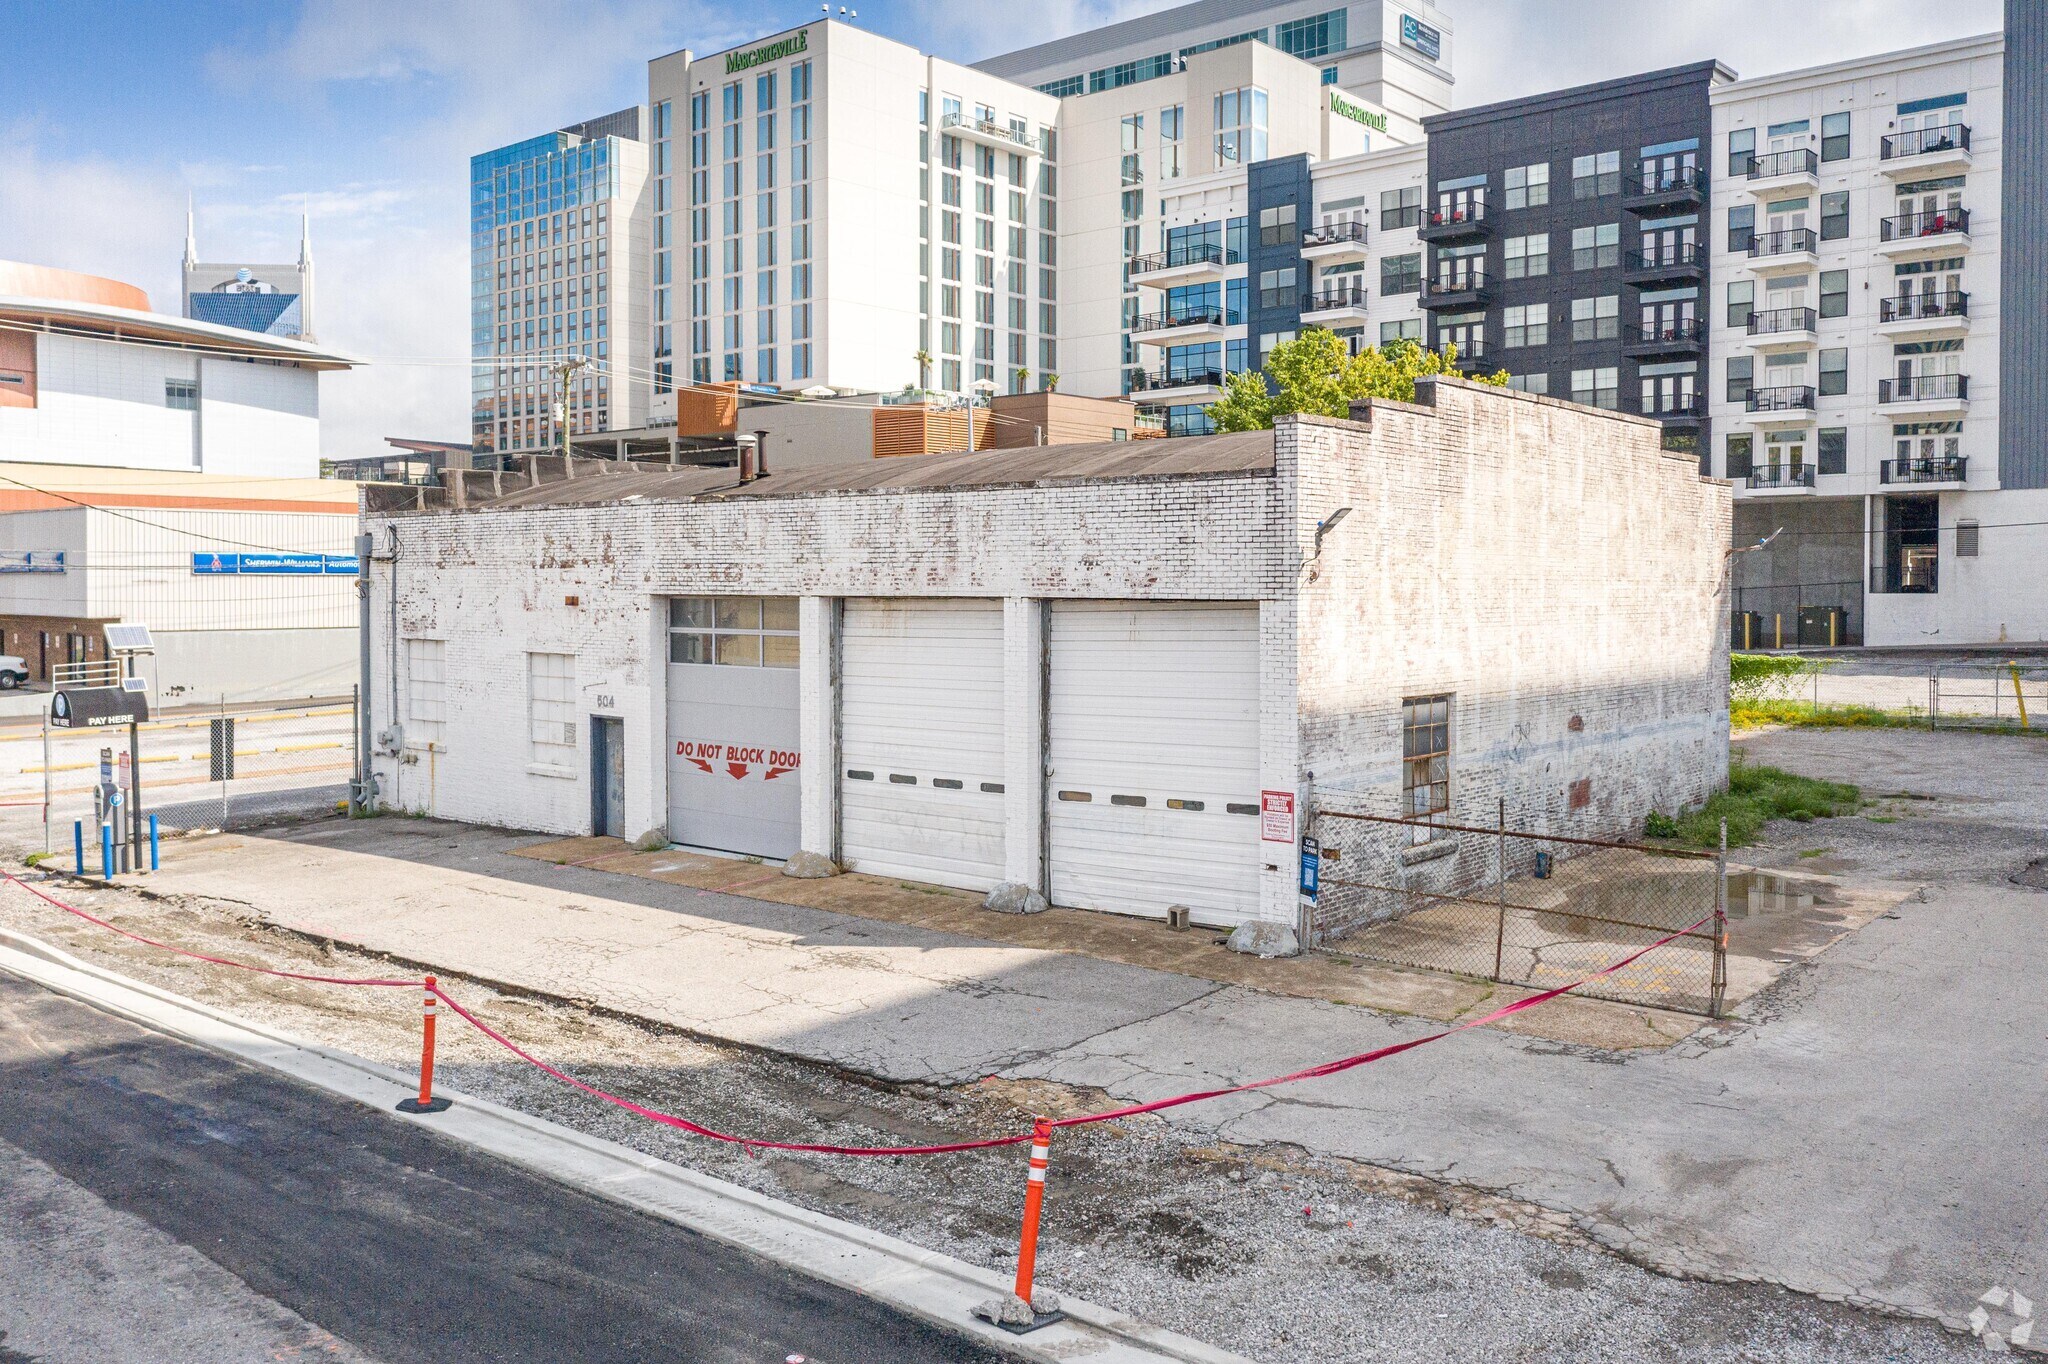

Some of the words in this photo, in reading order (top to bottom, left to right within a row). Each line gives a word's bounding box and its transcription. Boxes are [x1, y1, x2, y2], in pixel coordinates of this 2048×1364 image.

[1405, 19, 1417, 33] AC
[725, 29, 808, 74] MARGARITAVILLE
[597, 695, 615, 708] 504
[88, 716, 106, 726] PAY
[108, 714, 134, 724] HERE
[676, 741, 694, 756] DO
[697, 743, 722, 759] NOT
[726, 746, 765, 764] BLOCK
